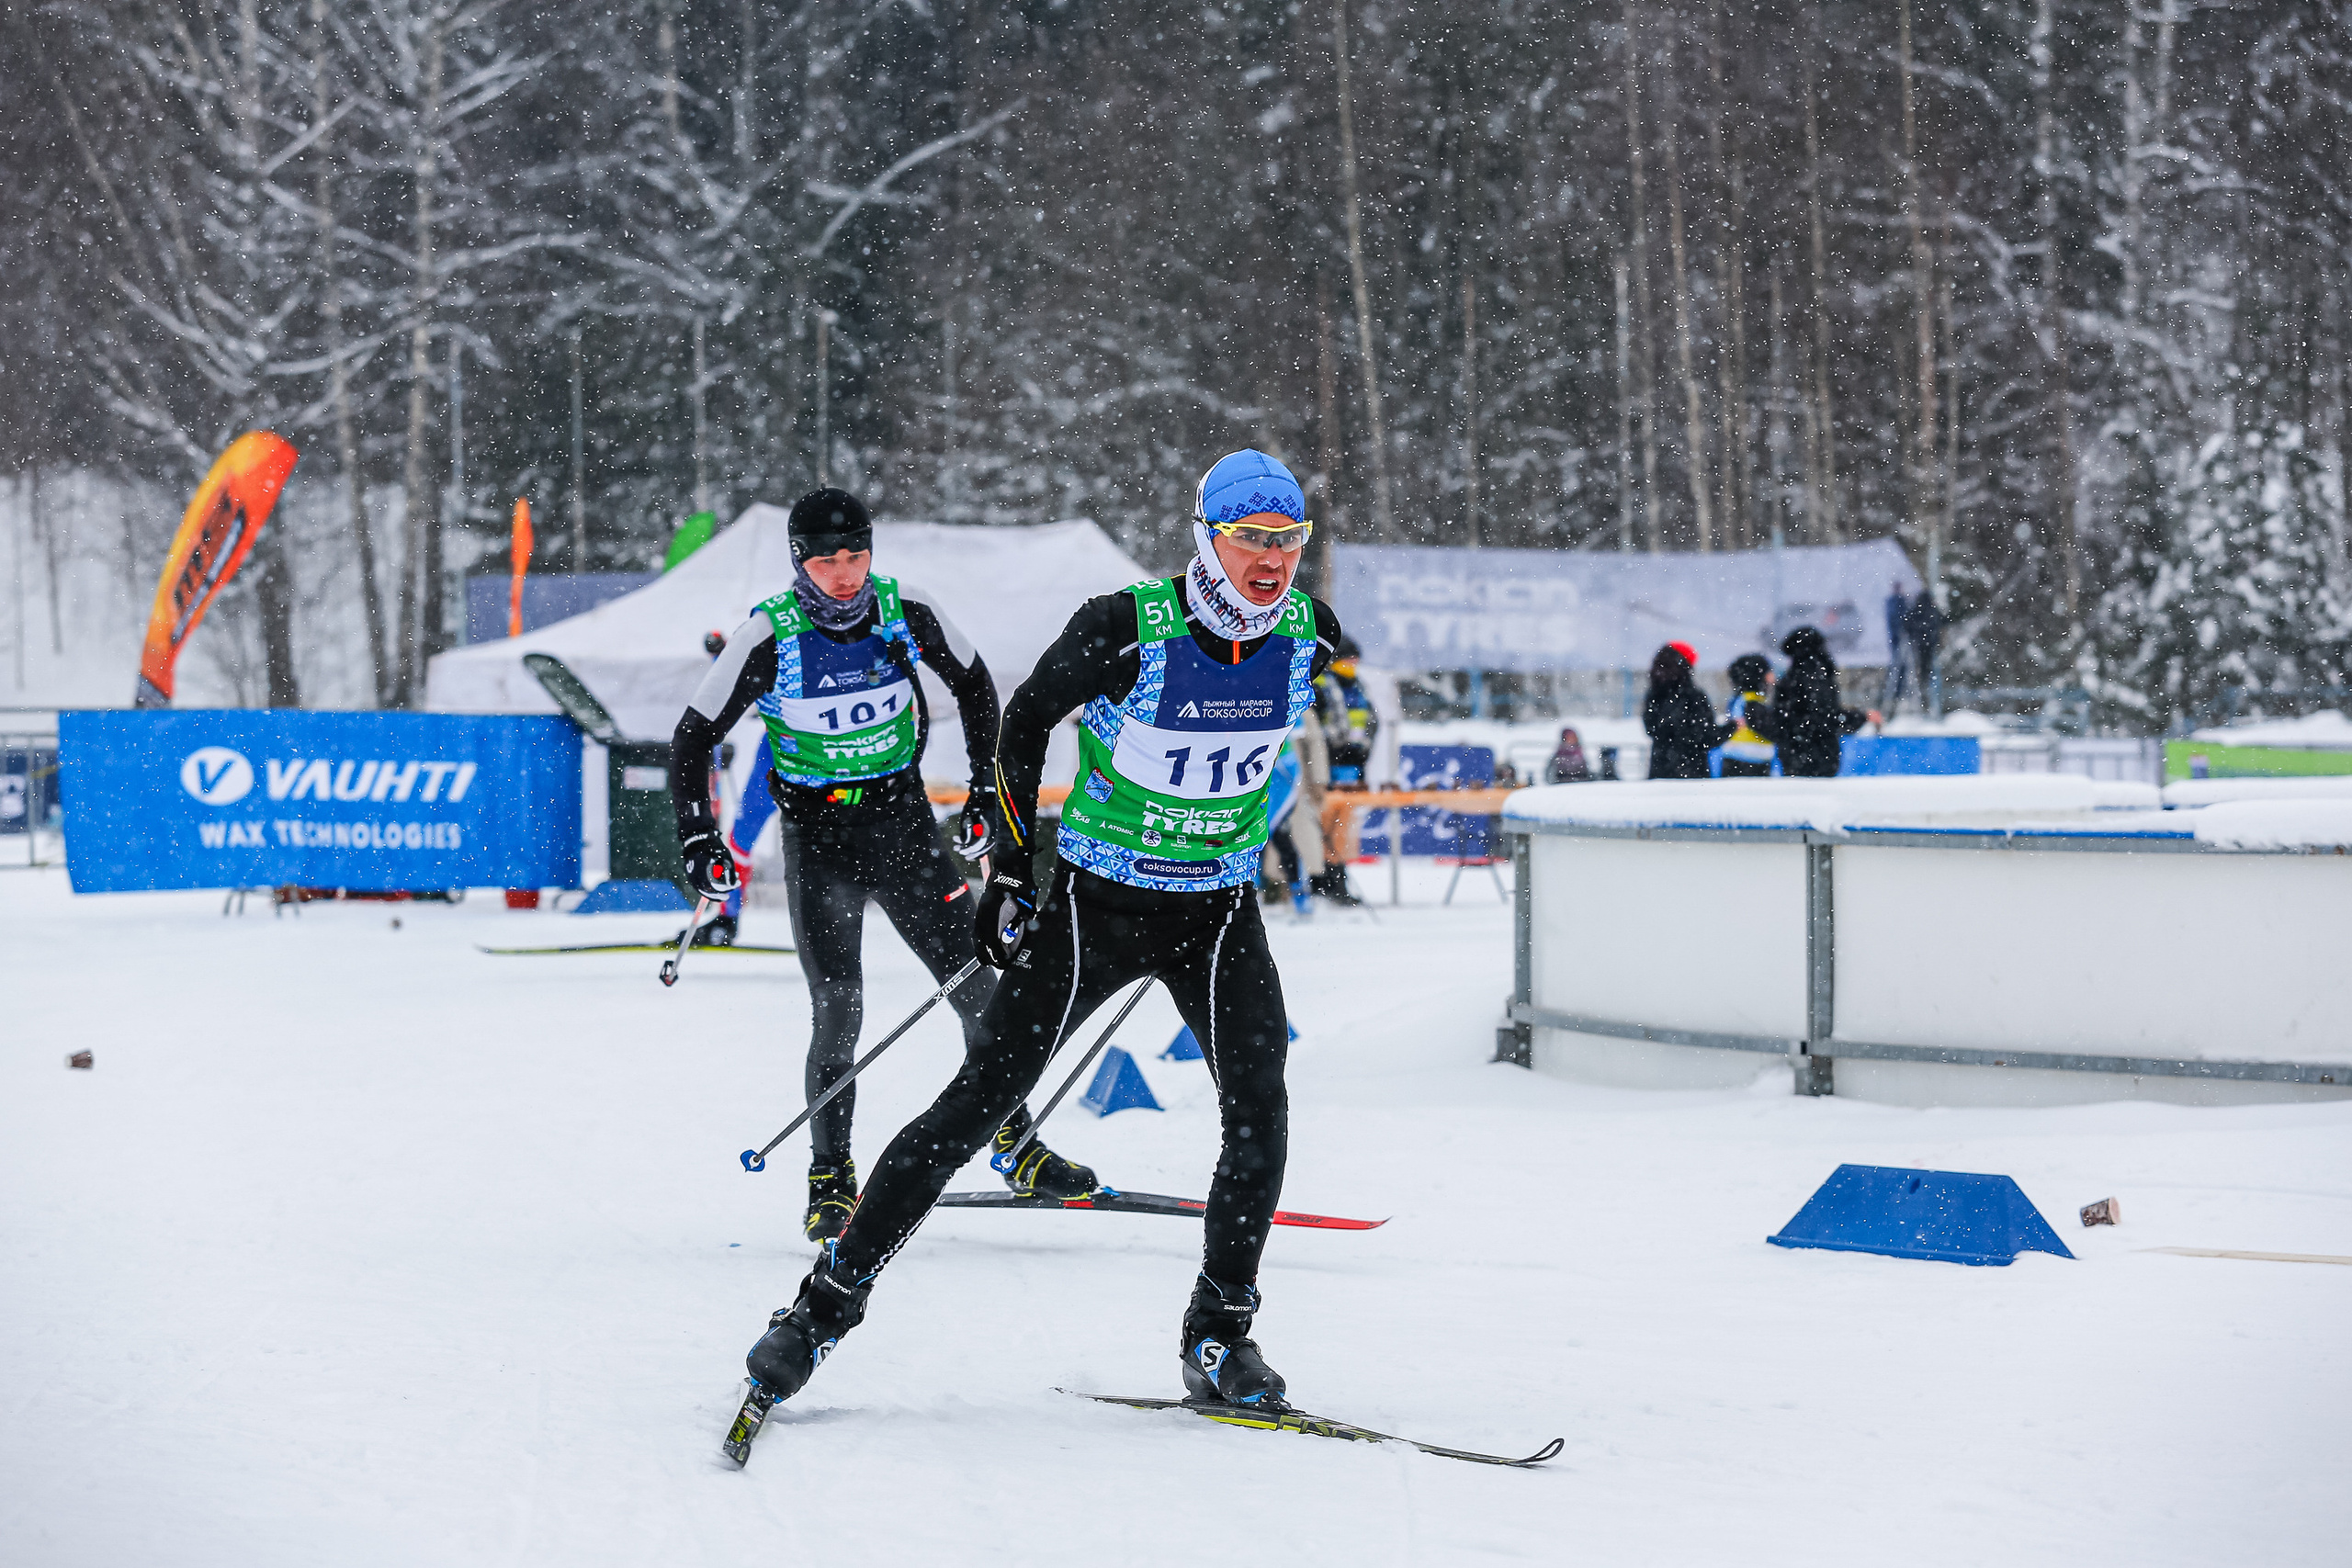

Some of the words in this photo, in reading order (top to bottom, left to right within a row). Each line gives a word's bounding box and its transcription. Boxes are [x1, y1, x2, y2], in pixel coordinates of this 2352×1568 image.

[775, 607, 800, 626] 51
[1144, 599, 1174, 625] 51
[1286, 597, 1308, 623] 51
[818, 694, 897, 730] 101
[1202, 707, 1272, 718] TOKSOVOCUP
[1203, 699, 1236, 707] ЛЫЖНЫЙ
[1239, 699, 1273, 707] МАРАФОН
[823, 734, 900, 760] TYRES
[266, 758, 478, 803] VAUHTI
[1164, 744, 1270, 794] 116
[198, 821, 266, 849] WAX
[273, 819, 461, 850] TECHNOLOGIES
[1107, 824, 1135, 836] ATOMIC
[1141, 810, 1238, 836] TYRES
[1143, 862, 1213, 876] toksovocup.ru
